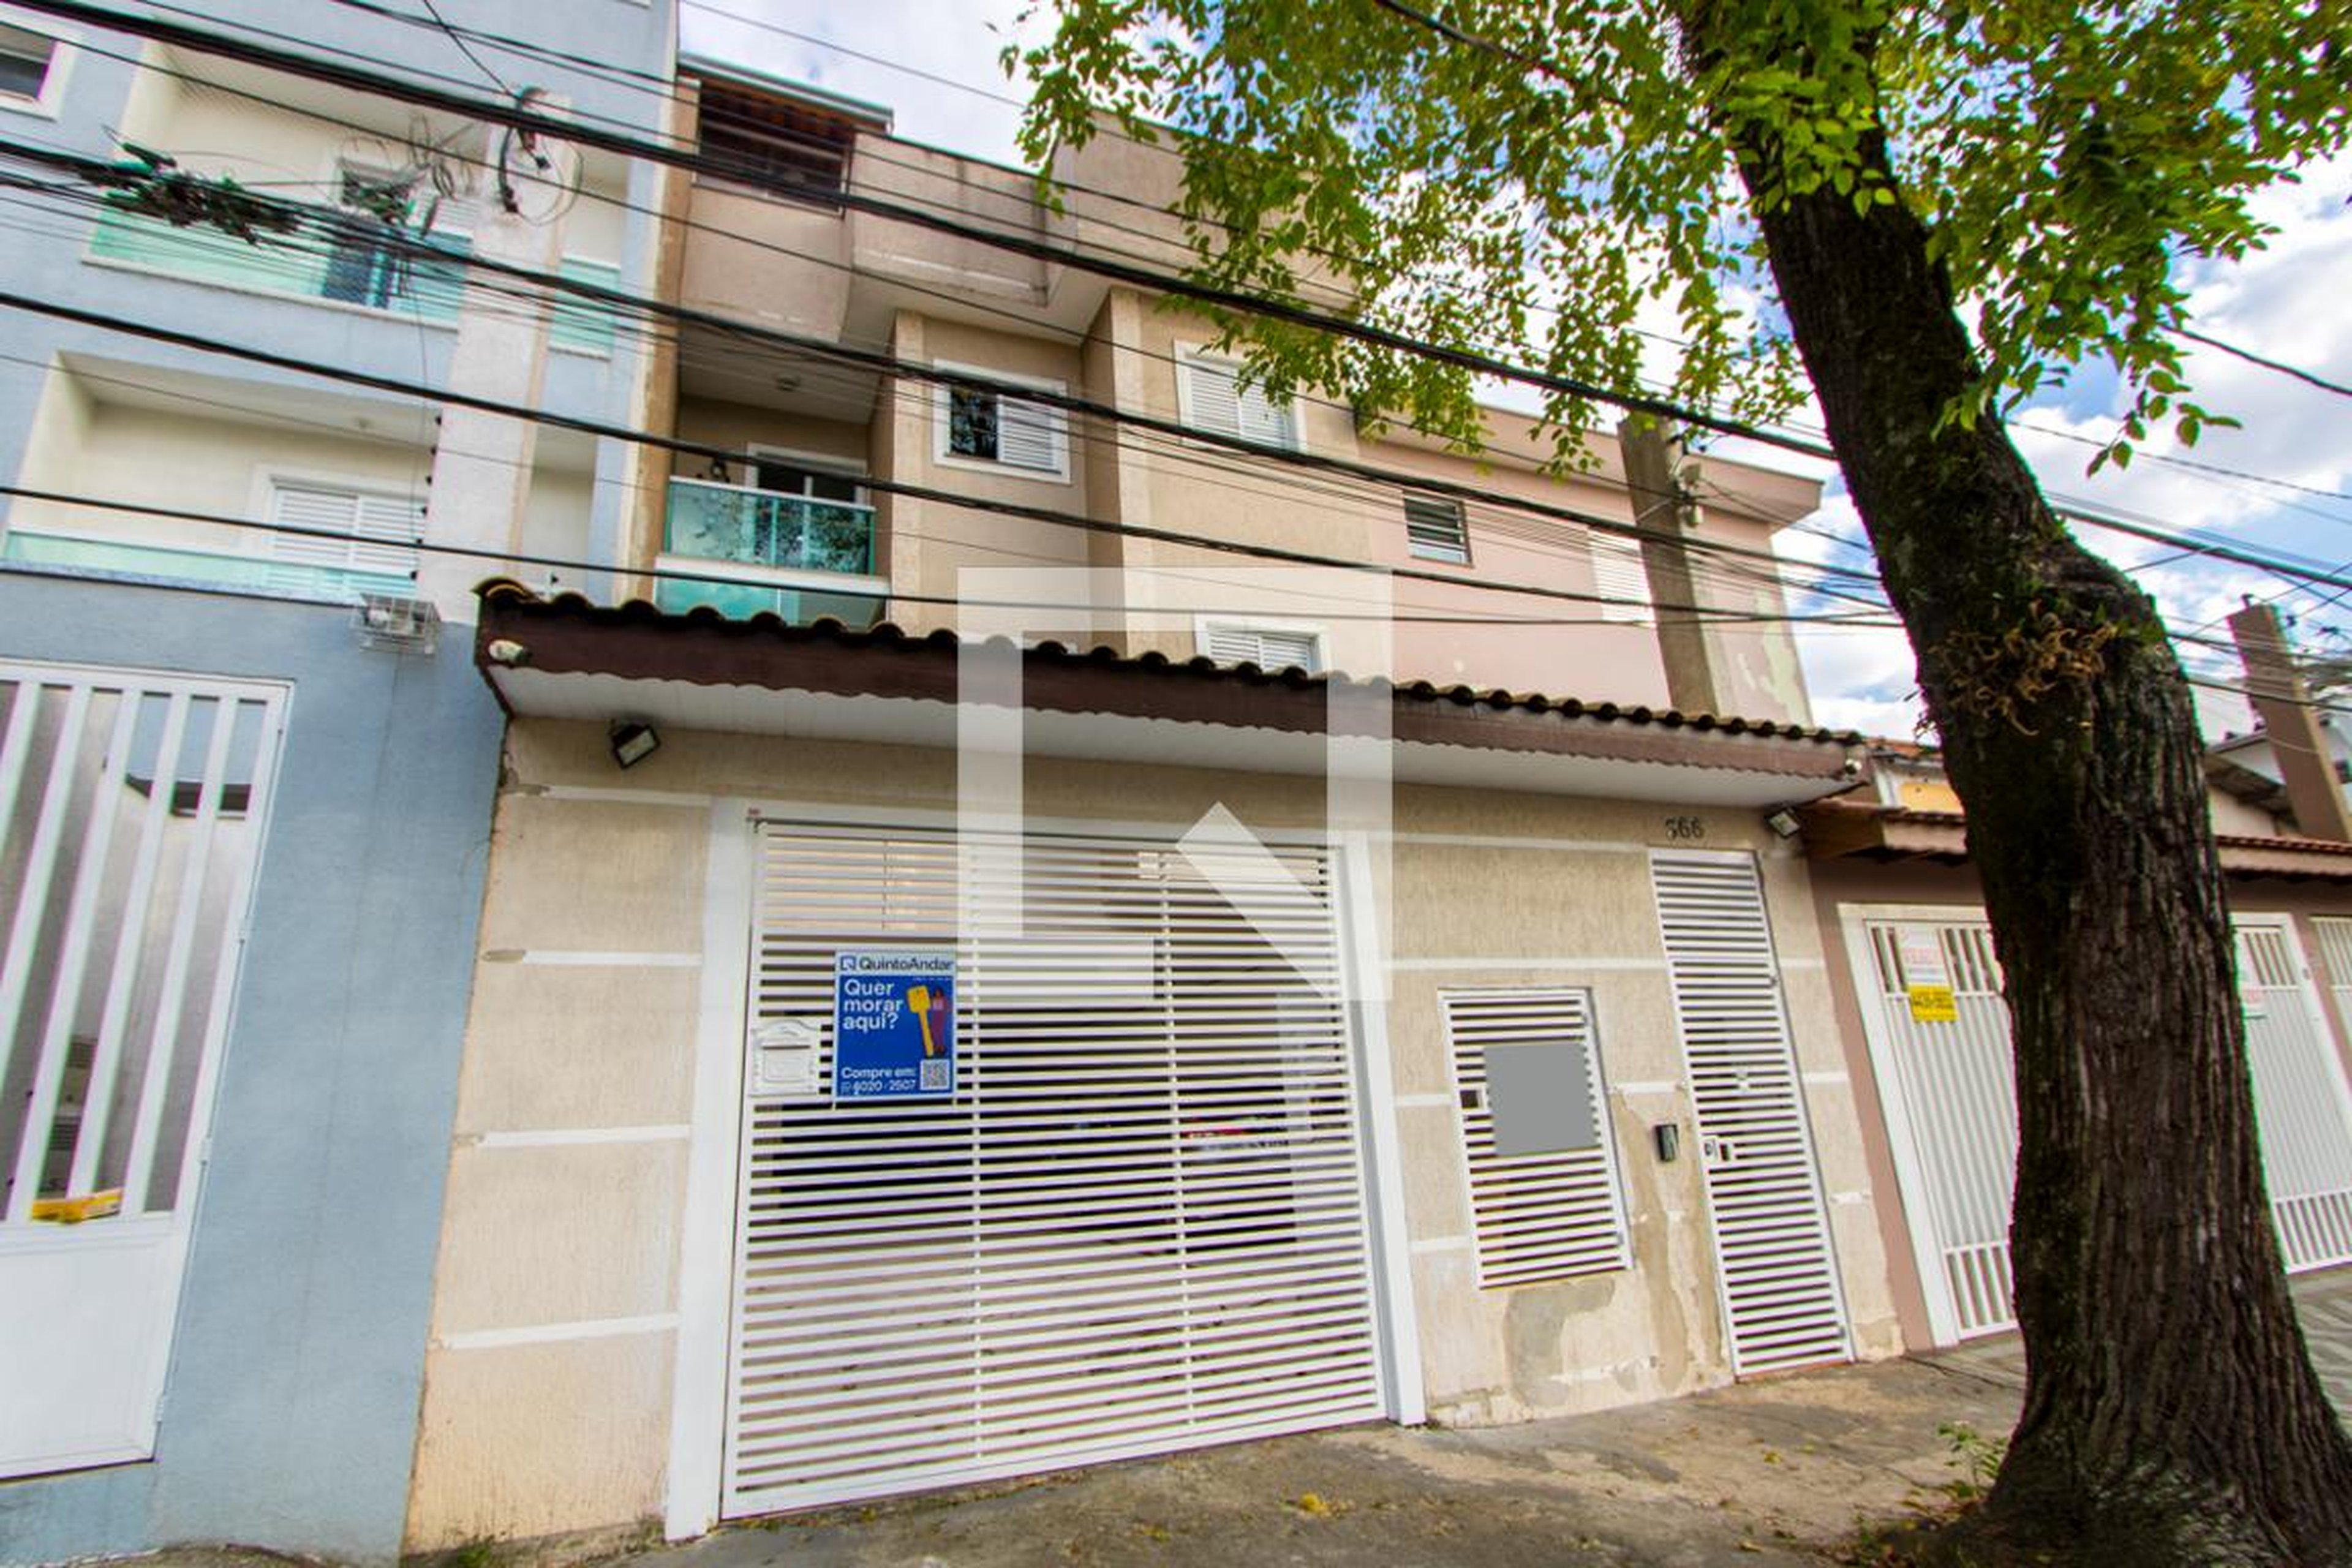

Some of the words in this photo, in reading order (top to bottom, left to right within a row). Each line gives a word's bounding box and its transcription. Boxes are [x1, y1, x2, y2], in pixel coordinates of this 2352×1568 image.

[1665, 816, 1704, 840] 566
[859, 956, 952, 970] QuintoAndar
[845, 979, 894, 995] Quer
[845, 999, 903, 1012] morar
[843, 1012, 899, 1033] aqui?
[841, 1067, 892, 1079] Compre
